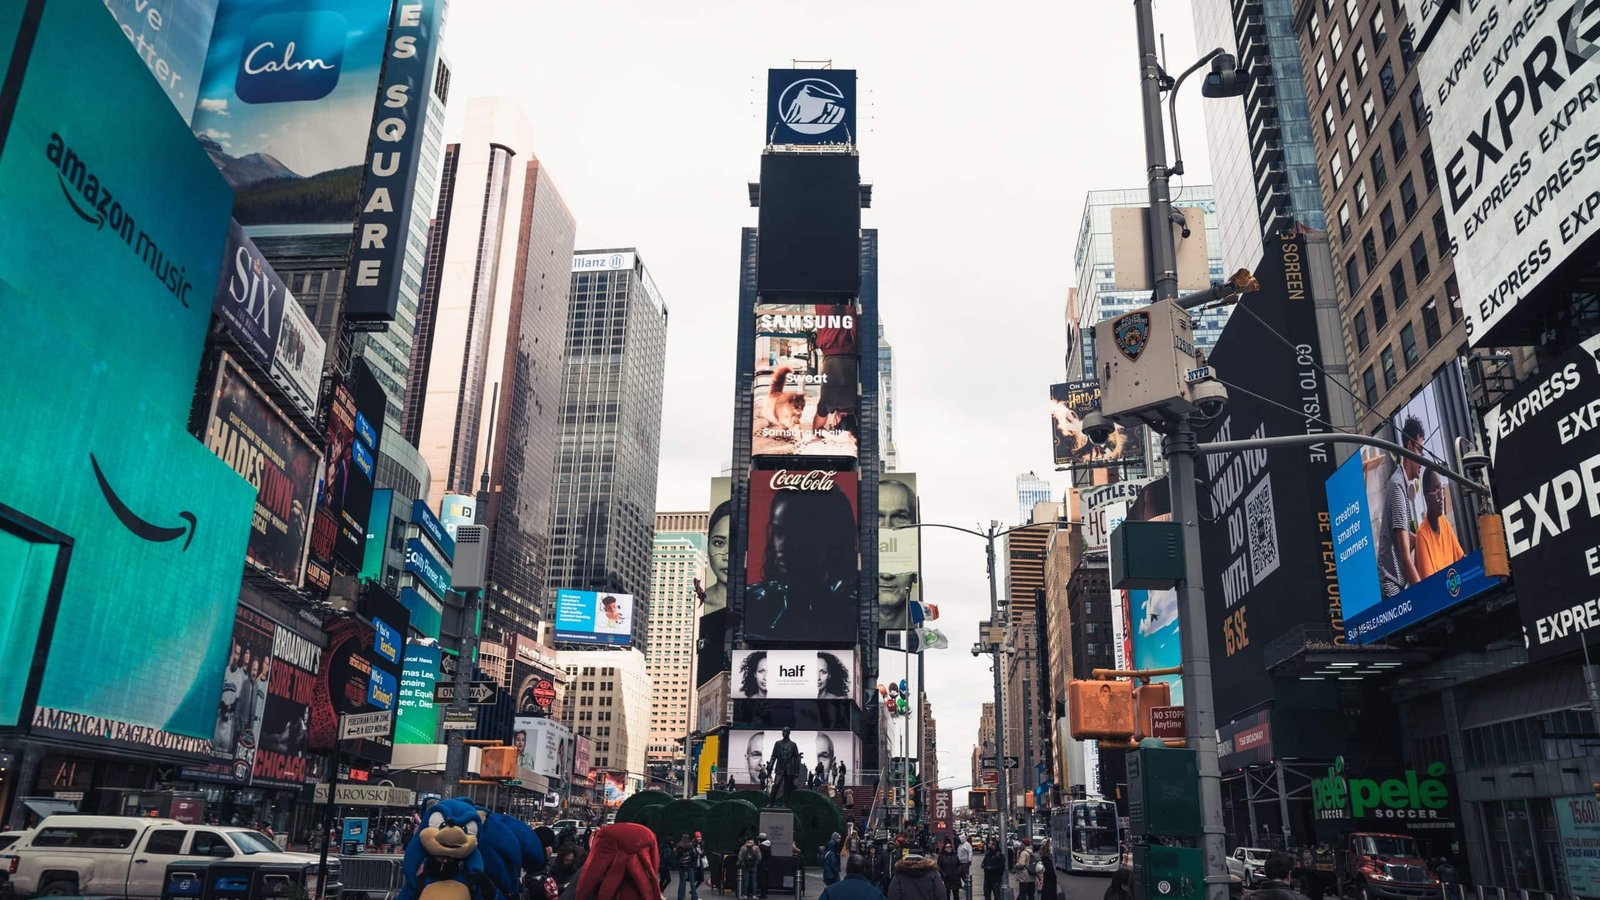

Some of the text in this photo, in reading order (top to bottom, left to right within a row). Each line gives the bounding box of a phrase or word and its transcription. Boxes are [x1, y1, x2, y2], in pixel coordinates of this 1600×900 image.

[244, 41, 335, 75] Calm
[1437, 4, 1500, 107] EXPRESS
[1483, 0, 1550, 88] EXPRES
[1444, 0, 1600, 215] EXPRE
[355, 83, 410, 287] SQUARE
[1464, 149, 1532, 242] EXPRESS
[46, 130, 194, 310] amazon music
[574, 257, 606, 268] llianz
[1282, 242, 1304, 301] SCREEN
[228, 246, 277, 339] SIX
[1478, 238, 1552, 323] EXPRESS
[760, 314, 854, 329] SAMSUNG
[1295, 343, 1314, 366] GO
[785, 372, 828, 384] Sweat
[1187, 367, 1209, 381] NYPD
[1299, 368, 1317, 390] TO
[1068, 392, 1094, 409] Harry
[1499, 363, 1581, 440] EXPRESS
[762, 427, 813, 439] Samsung
[1088, 484, 1126, 510] LITTLE
[1317, 511, 1330, 533] BE
[1335, 499, 1361, 528] creating
[1228, 506, 1244, 555] DO
[1337, 519, 1361, 545] smarter
[1339, 535, 1369, 564] summers
[1221, 552, 1250, 609] WITH
[1535, 597, 1600, 645] EXPRE
[273, 624, 322, 675] BROADWAY'S
[268, 659, 294, 700] SURE
[421, 669, 435, 680] Lee,
[779, 664, 805, 677] half
[1153, 711, 1164, 719] NO
[1154, 720, 1182, 730] Anytime
[31, 708, 214, 755] AMERICAN EAGLE OUTFITTERS
[253, 750, 306, 783] CHICAGO
[1312, 755, 1348, 820] pelé
[1348, 761, 1449, 818] pelé
[935, 791, 949, 819] tkts
[1321, 809, 1344, 820] SOCCER
[1375, 809, 1438, 819] SOCCER
[1568, 799, 1598, 824] 1560
